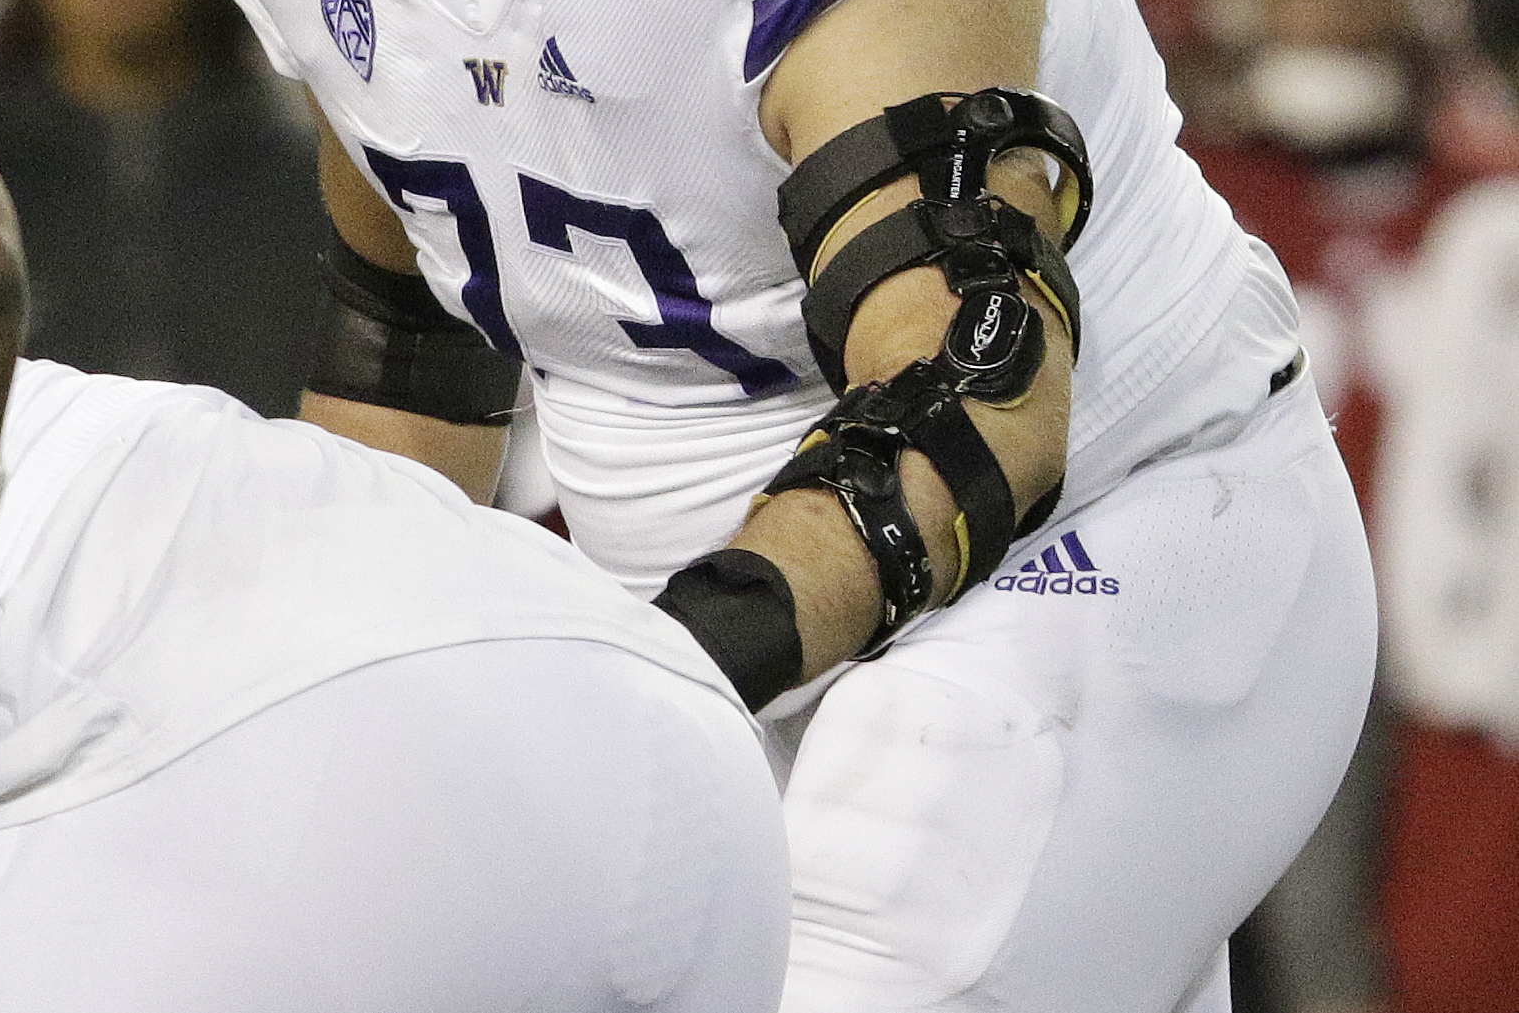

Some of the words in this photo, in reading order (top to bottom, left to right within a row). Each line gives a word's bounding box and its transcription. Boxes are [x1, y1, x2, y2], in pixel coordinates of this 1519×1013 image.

[341, 30, 368, 63] 12
[462, 58, 509, 108] W
[537, 72, 596, 104] adidas
[362, 144, 801, 398] 73
[969, 294, 1002, 362] DONJOY
[993, 570, 1121, 597] adidas
